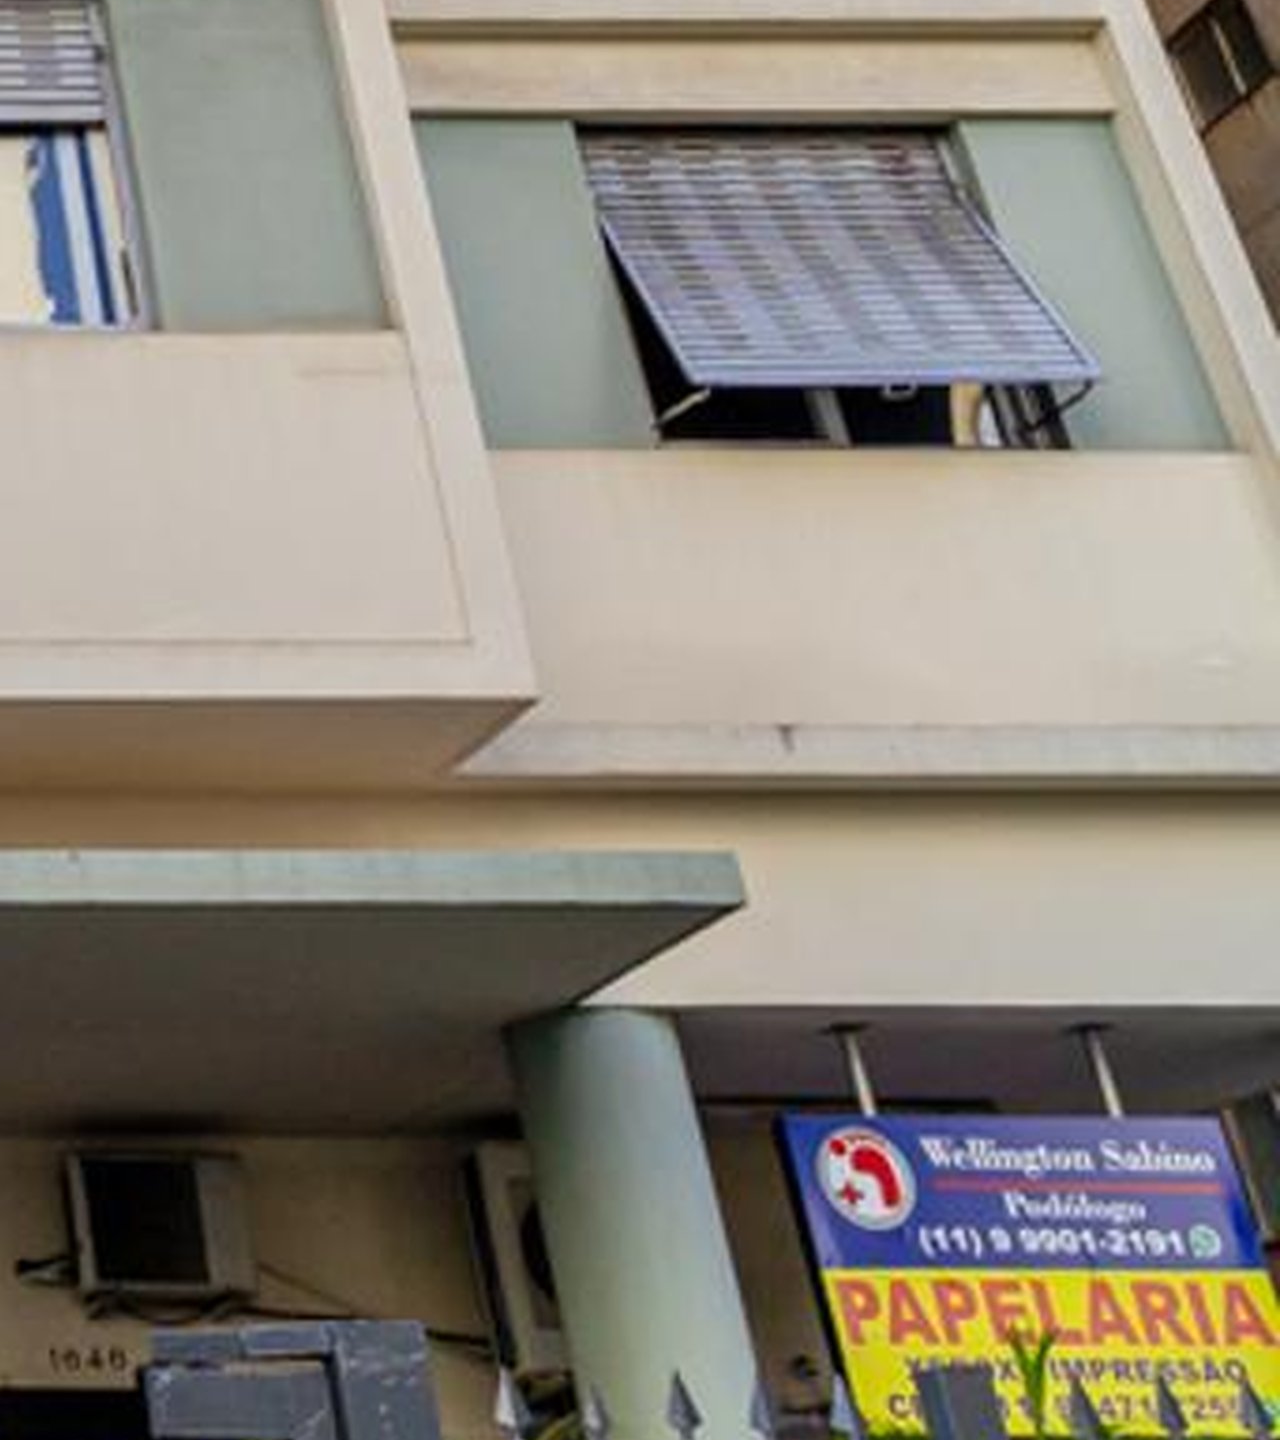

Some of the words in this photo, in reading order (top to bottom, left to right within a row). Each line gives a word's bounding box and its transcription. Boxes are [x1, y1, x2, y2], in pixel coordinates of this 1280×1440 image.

[919, 1136, 1094, 1180] Wellington
[919, 1226, 983, 1258] (11)
[836, 1275, 1280, 1347] PAPELARIA
